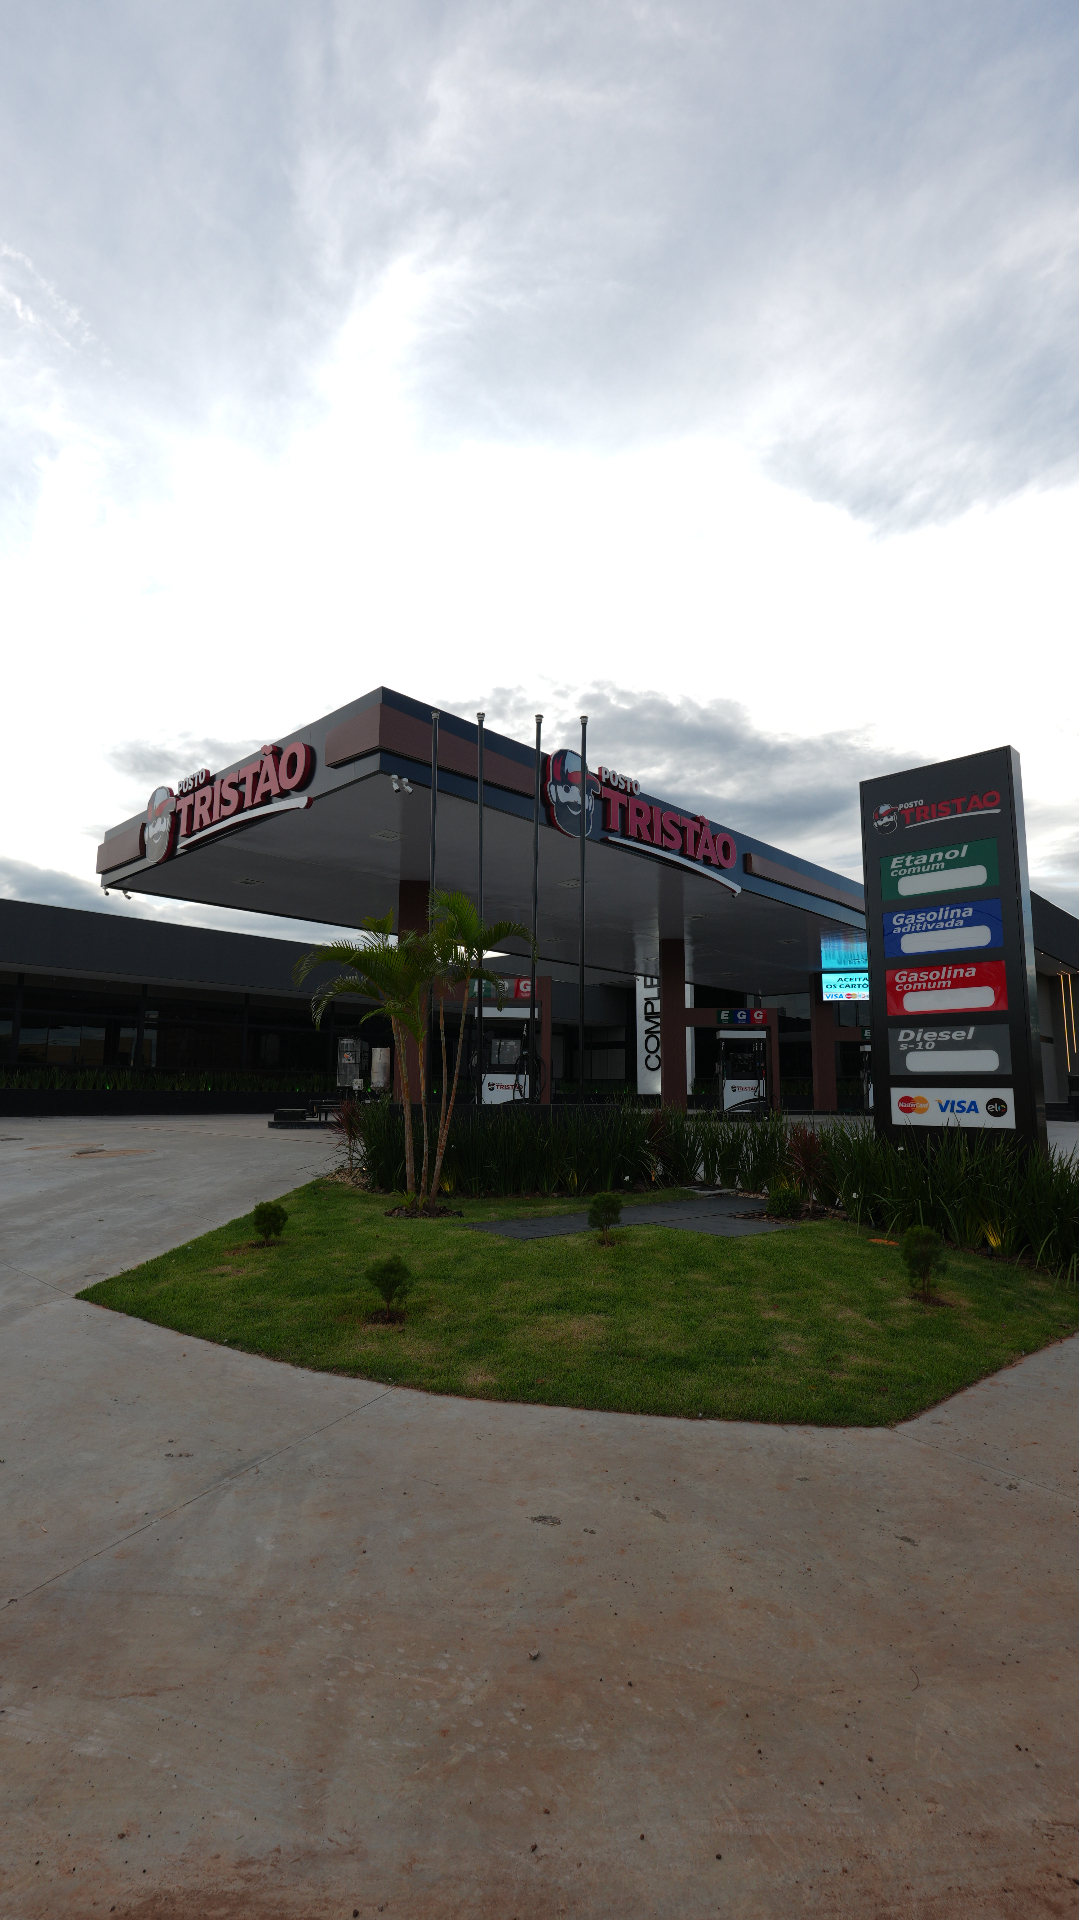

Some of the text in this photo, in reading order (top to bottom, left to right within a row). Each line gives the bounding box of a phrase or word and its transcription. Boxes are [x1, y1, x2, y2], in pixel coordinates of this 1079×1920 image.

[177, 767, 208, 796] POSTO
[600, 766, 641, 796] POSTO
[175, 742, 311, 838] TRISTÃO
[898, 799, 924, 811] POSTO
[900, 790, 1001, 825] TRISTÃO
[602, 786, 738, 869] TRISTÃO
[890, 844, 969, 870] Etanol
[890, 861, 945, 877] comum
[892, 906, 974, 926] Gasolina
[892, 918, 965, 934] aditivada
[894, 966, 977, 983] Gasolina
[519, 980, 532, 992] G
[895, 979, 952, 992] comum
[720, 1010, 764, 1020] E G G
[863, 1029, 871, 1037] E
[896, 1026, 975, 1043] Diesel
[898, 1099, 1006, 1114] MasterCard VISA elo
